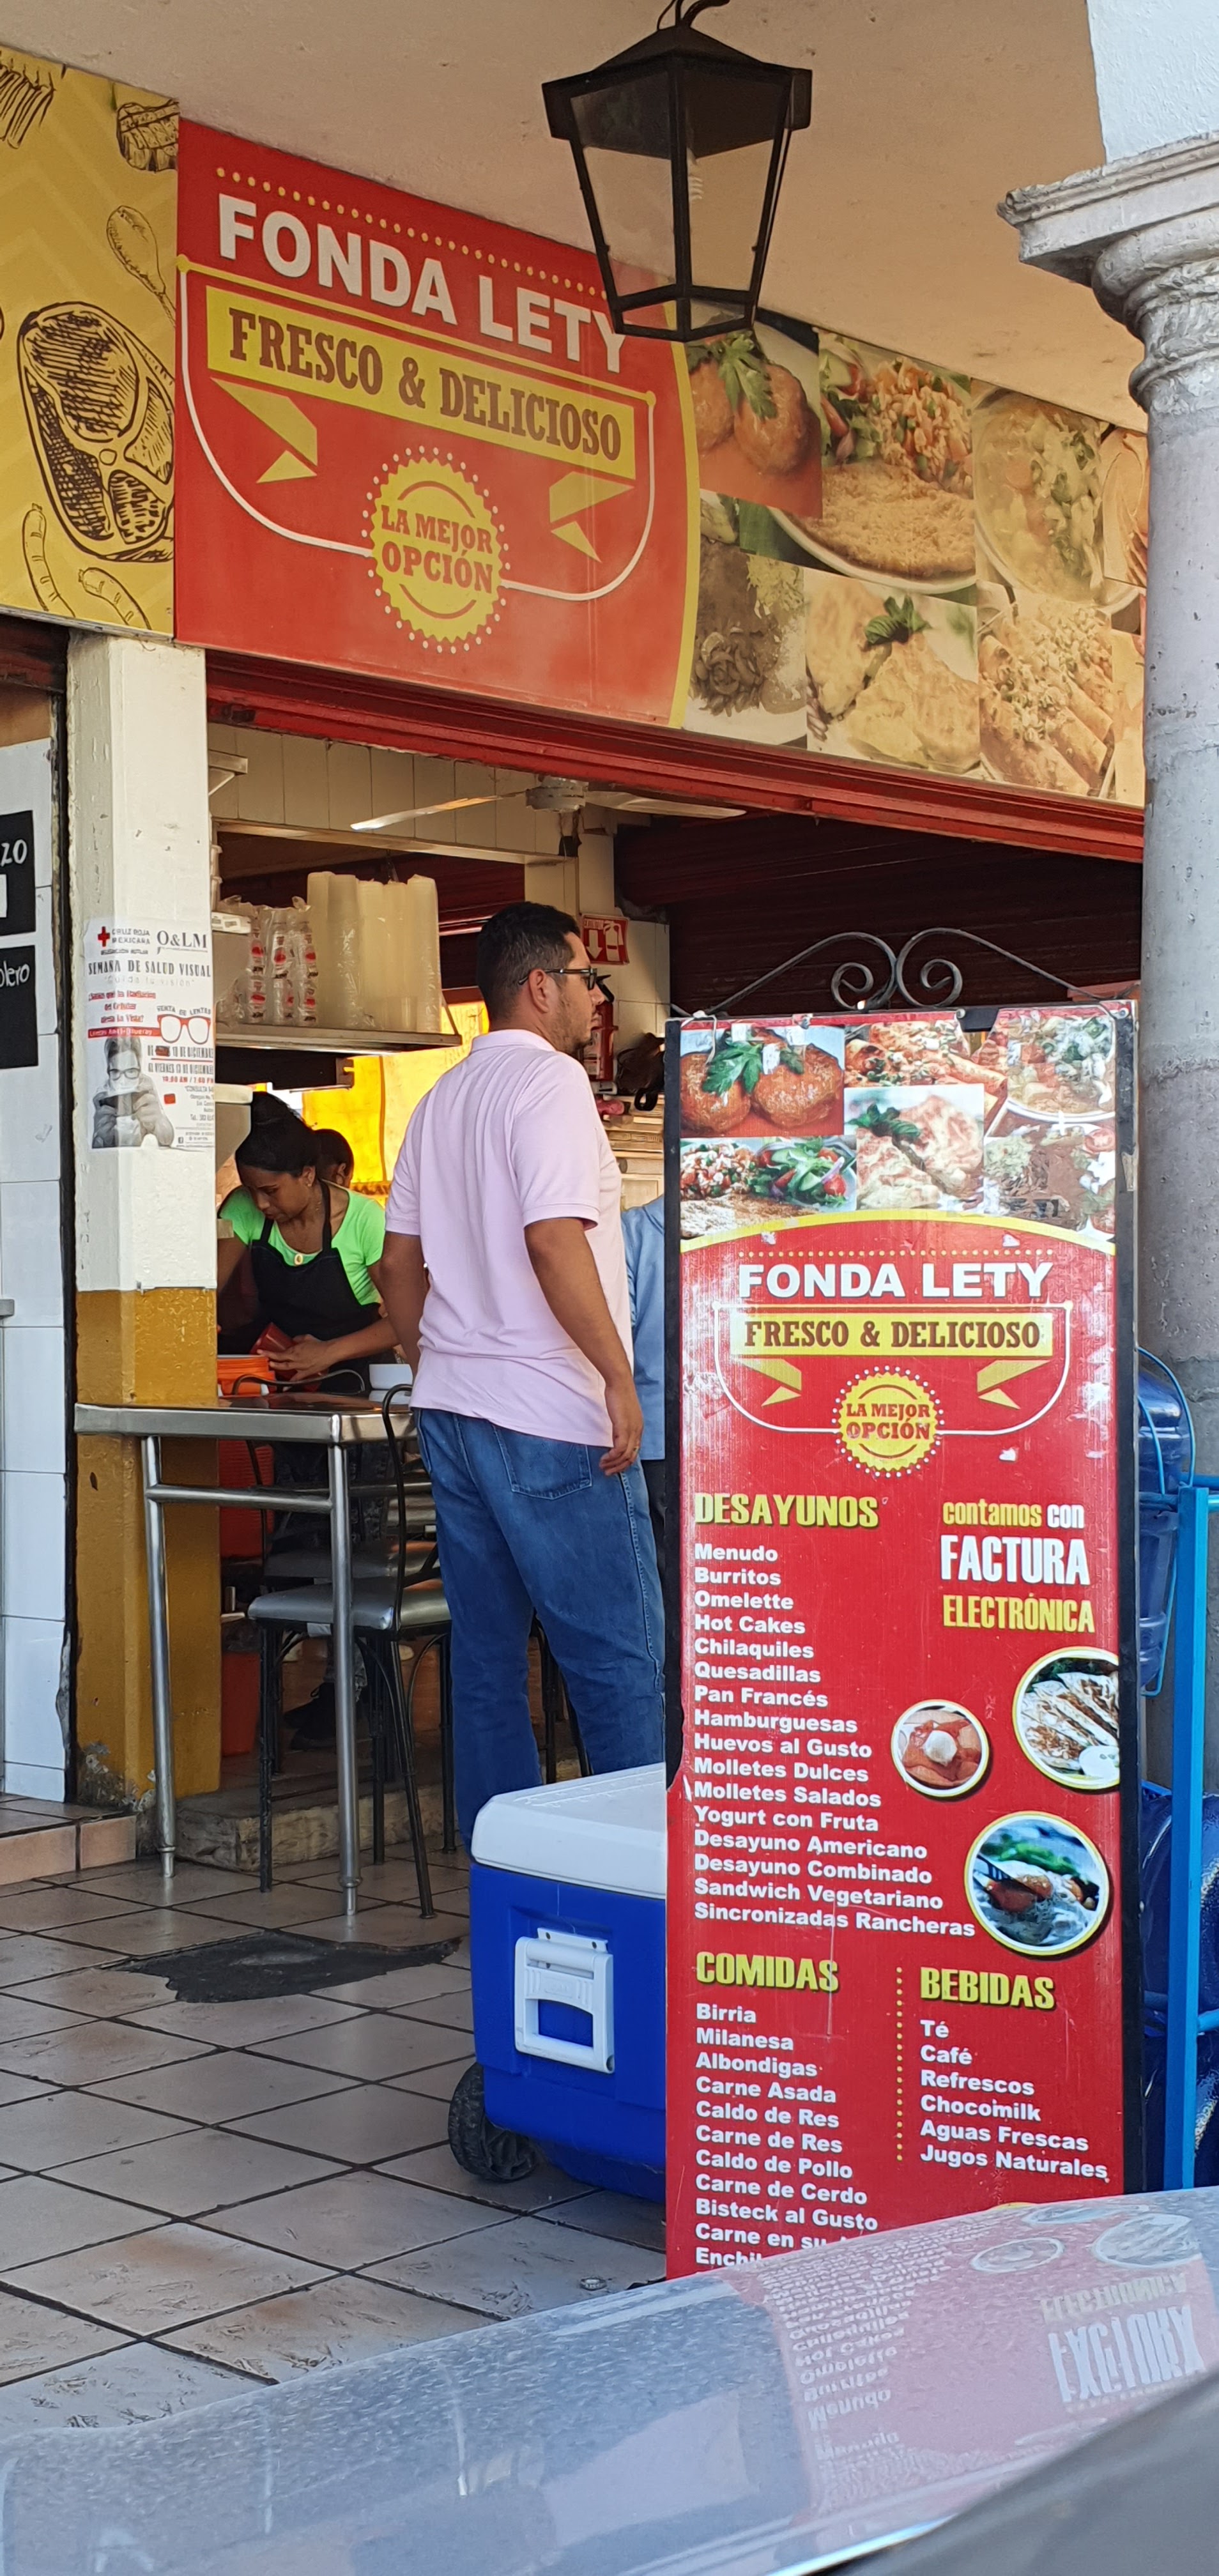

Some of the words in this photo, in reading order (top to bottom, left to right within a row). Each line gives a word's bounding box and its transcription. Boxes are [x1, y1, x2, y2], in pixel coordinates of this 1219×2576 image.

[218, 194, 457, 325] FONDA
[479, 275, 626, 374] LETY
[229, 307, 383, 395] FRESCO
[399, 357, 425, 409] &
[440, 369, 621, 461] DELICIOSO
[381, 505, 410, 533] LA
[415, 516, 492, 554] MEJOR
[383, 547, 493, 594] OPCIÓN
[157, 930, 207, 947] O&LM
[89, 960, 121, 975] SEMANA
[128, 960, 140, 972] DE
[146, 961, 174, 974] SALUD
[180, 963, 211, 977] VISUAL
[739, 1264, 905, 1298] FONDA
[923, 1262, 1053, 1298] LETY
[744, 1320, 848, 1347] FRESCO
[861, 1321, 880, 1347] &
[891, 1321, 1039, 1348] DELICIOSO
[846, 1404, 868, 1417] LA
[871, 1404, 930, 1420] MEJOR
[846, 1418, 931, 1441] OPCIÓN
[694, 1493, 879, 1528] DESAYUNOS
[943, 1499, 1042, 1527] contamos
[1046, 1506, 1084, 1528] con
[694, 1544, 778, 1562] Menudo
[940, 1535, 1090, 1586] FACTURA
[694, 1567, 781, 1586] Burritos
[694, 1591, 793, 1610] Omelette
[943, 1593, 1095, 1632] ELECTRÓNICA
[694, 1614, 732, 1632] Hot
[739, 1616, 805, 1634] Cakes
[694, 1639, 814, 1660] Chilaquiles
[694, 1661, 820, 1682] Quesadillas
[694, 1685, 733, 1703] Pan
[742, 1687, 828, 1707] Francés
[694, 1708, 857, 1734] Hamburguesas
[694, 1733, 773, 1752] Huevos
[780, 1738, 799, 1754] al
[807, 1739, 872, 1758] Gusto
[694, 1758, 786, 1777] Molletes
[794, 1763, 868, 1782] Dulces
[694, 1781, 786, 1802] Molletes
[794, 1786, 881, 1807] Salados
[694, 1805, 766, 1827] Yogurt
[773, 1814, 812, 1827] con
[821, 1813, 878, 1831] Fruta
[694, 1829, 800, 1853] Desayuno
[808, 1836, 927, 1859] Americano
[693, 1853, 800, 1877] Desayuno
[808, 1860, 931, 1883] Combinado
[694, 1878, 800, 1900] Sandwich
[808, 1885, 943, 1909] Vegetariano
[694, 1902, 848, 1928] Sincronizadas
[856, 1912, 975, 1936] Rancheras
[696, 1952, 839, 1992] COMIDAS
[921, 1967, 1055, 2009] BEBIDAS
[697, 2004, 756, 2023] Birria
[697, 2028, 793, 2050] Milanesa
[921, 2020, 949, 2037] Té
[696, 2052, 817, 2078] Albondigas
[921, 2045, 972, 2064] Café
[696, 2076, 761, 2096] Carne
[768, 2082, 836, 2103] Asada
[921, 2070, 1034, 2095] Refrescos
[696, 2101, 757, 2121] Caldo
[765, 2107, 791, 2124] de
[799, 2109, 839, 2128] Res
[921, 2095, 1041, 2121] Chocomilk
[696, 2125, 761, 2145] Carne
[768, 2131, 794, 2149] de
[802, 2134, 842, 2152] Res
[921, 2120, 990, 2142] Aguas
[999, 2126, 1088, 2150] Frescas
[696, 2149, 757, 2170] Caldo
[765, 2156, 791, 2173] de
[799, 2158, 852, 2178] Pollo
[921, 2145, 988, 2167] Jugos
[995, 2152, 1107, 2179] Naturales
[696, 2174, 760, 2195] Carne
[768, 2181, 794, 2198] de
[802, 2183, 867, 2204] Cerdo
[696, 2198, 778, 2221] Bisteck
[785, 2208, 804, 2223] al
[813, 2209, 878, 2230] Gusto
[696, 2223, 760, 2244] Carne
[768, 2234, 793, 2248] en
